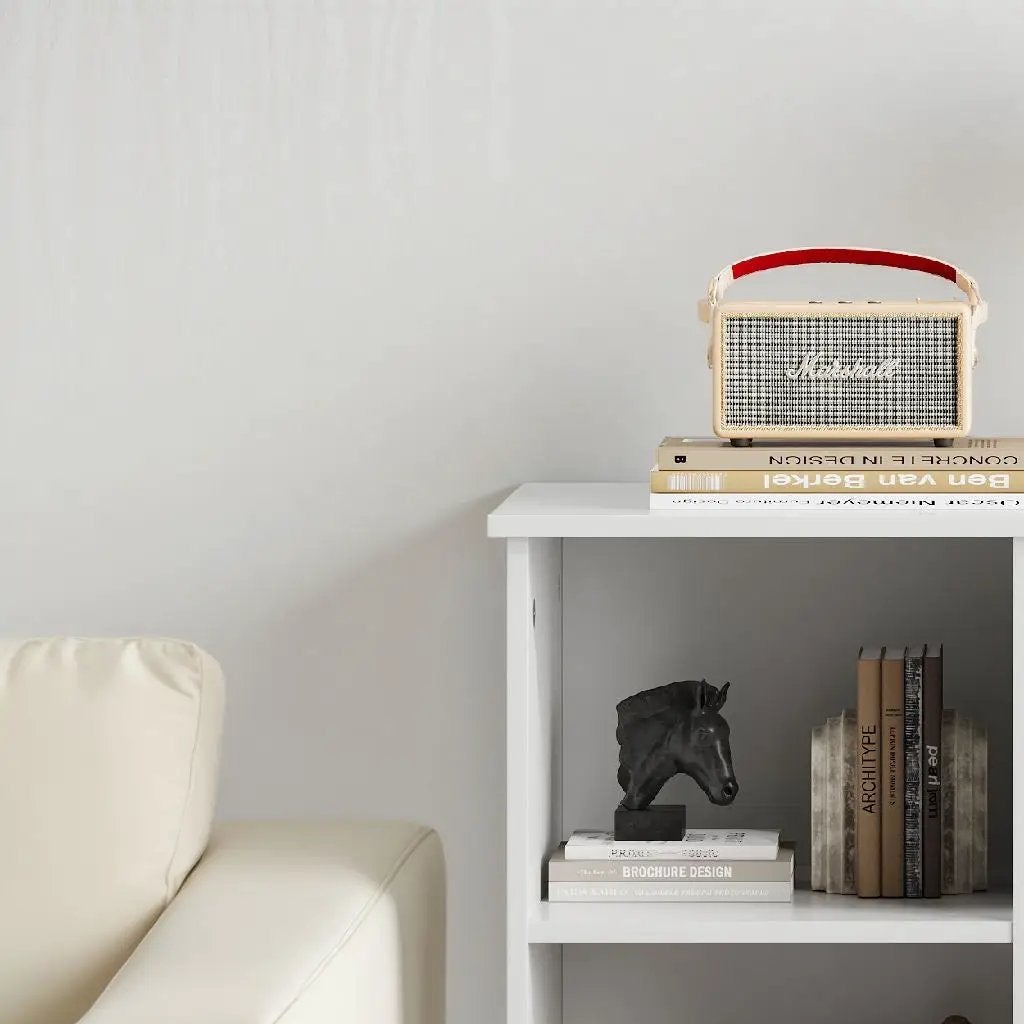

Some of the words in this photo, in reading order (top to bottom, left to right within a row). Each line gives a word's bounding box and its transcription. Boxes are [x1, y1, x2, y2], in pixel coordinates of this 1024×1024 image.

[785, 352, 900, 380] Marshall
[769, 454, 855, 465] DESIGN
[862, 454, 883, 465] IN
[891, 454, 1018, 465] CONCRETE
[763, 473, 865, 489] Berkel
[878, 473, 937, 487] van
[948, 473, 1010, 489] Ben
[861, 725, 877, 814] ARCHITYPE
[926, 745, 941, 786] pearl
[622, 866, 687, 879] BROCHURE
[689, 866, 733, 879] DESIGN
